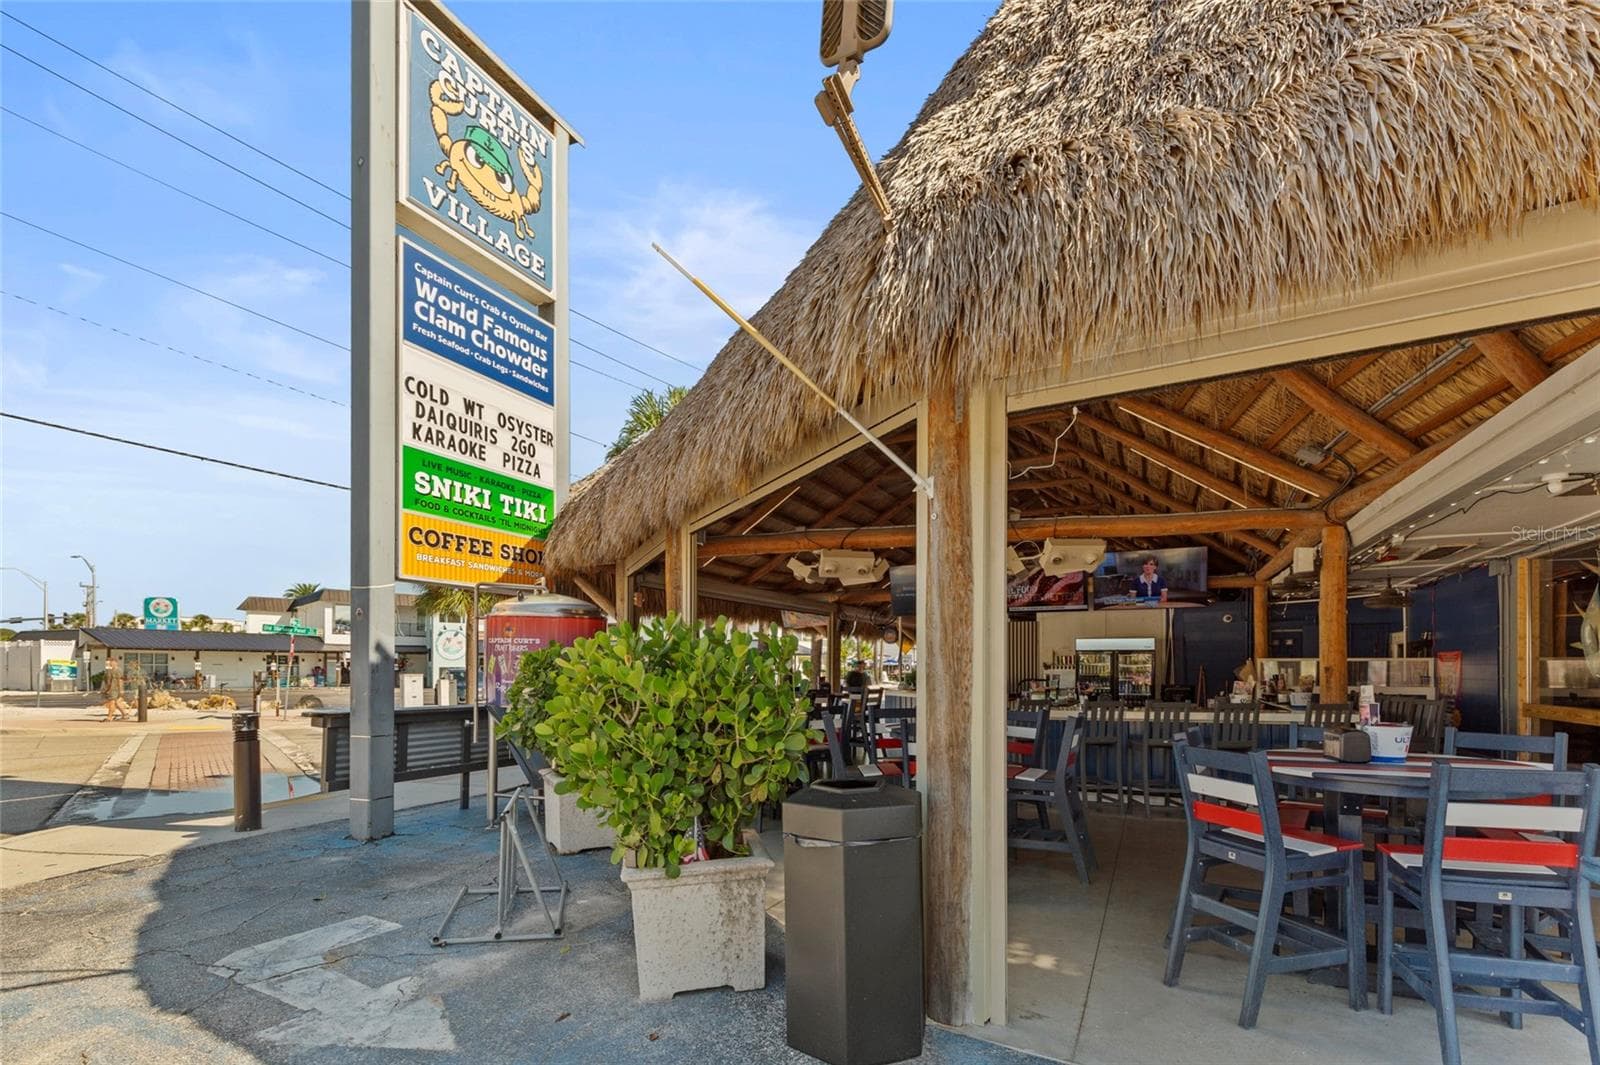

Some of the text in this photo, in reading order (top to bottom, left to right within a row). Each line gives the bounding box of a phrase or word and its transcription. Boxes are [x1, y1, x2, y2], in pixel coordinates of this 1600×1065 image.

[421, 30, 548, 158] CAPTAIN
[439, 69, 537, 167] CURT'S
[423, 177, 546, 280] VILLAGE
[414, 262, 548, 343] Captain Curt's Crab & Oyster Bar
[414, 277, 548, 362] World Famous
[412, 323, 549, 393] Fresh Seafood Crab Legs Sandwiches
[414, 301, 548, 380] Clam Chowder
[405, 376, 554, 448] COLD WT OSYSTER
[416, 401, 536, 458] DAIQUIRIS 2GO
[412, 422, 541, 479] KARAOKE PIZZA
[422, 459, 542, 499] LIVE MUSIC KARAOKE PIZZA
[414, 471, 547, 525] SNIKI TIKI
[415, 498, 441, 511] FOOD
[452, 507, 497, 524] COCKTAILS
[513, 521, 547, 535] MIDNIGH
[408, 526, 493, 557] COFFEE
[416, 553, 465, 567] BREAKFAST
[468, 561, 516, 576] SANDWICHES
